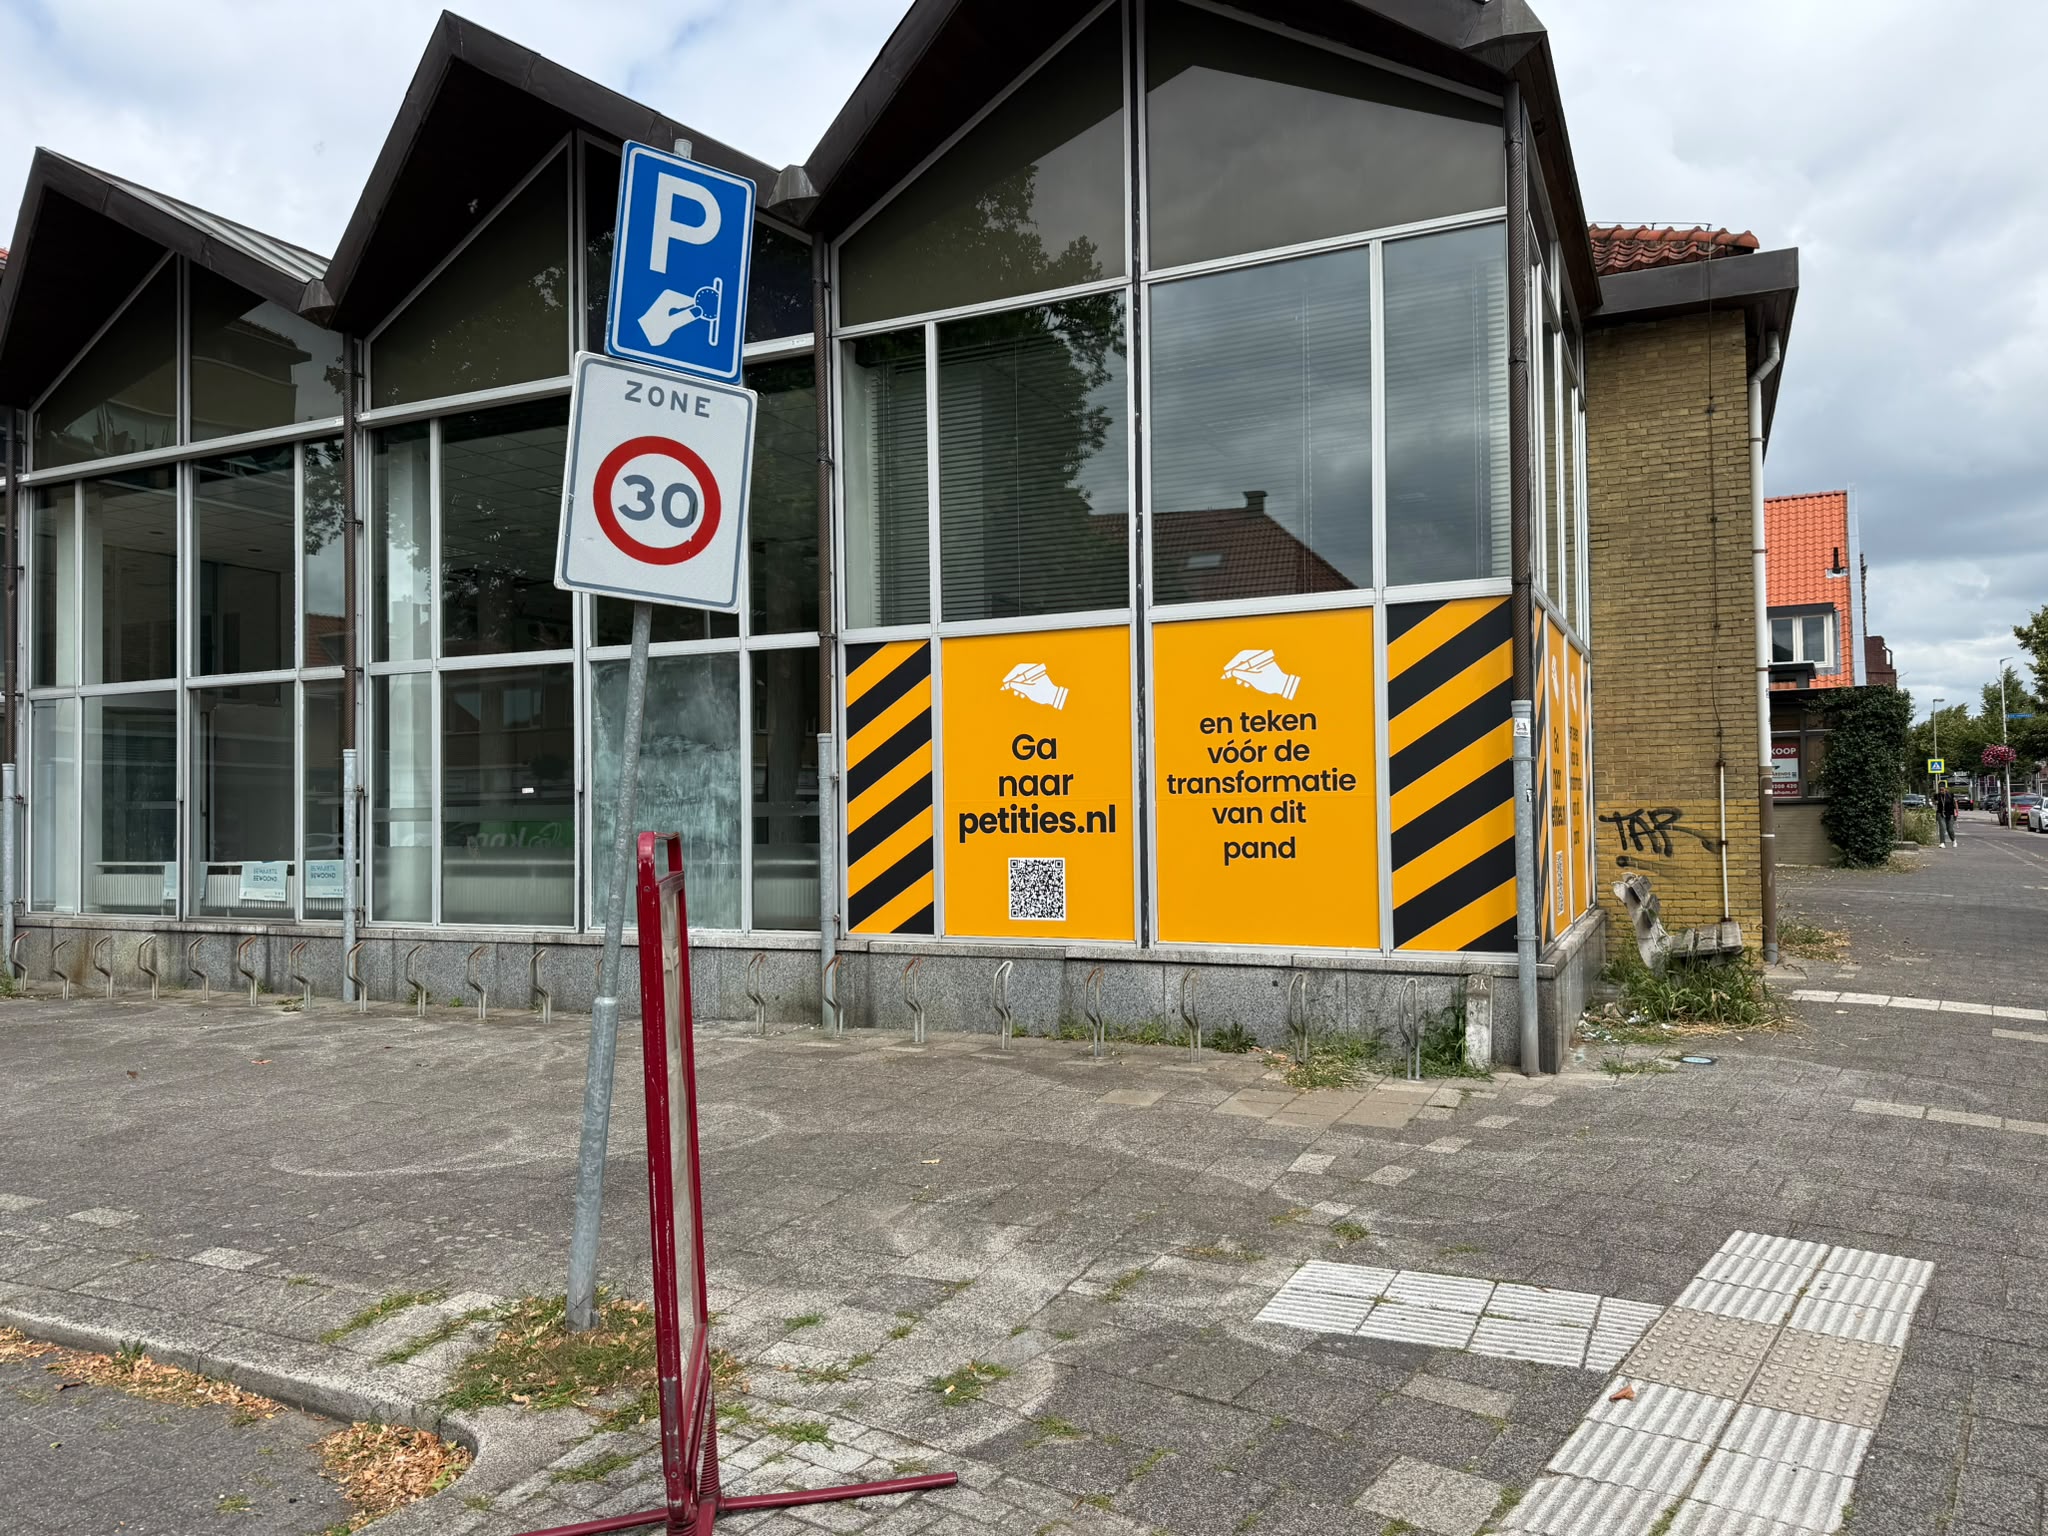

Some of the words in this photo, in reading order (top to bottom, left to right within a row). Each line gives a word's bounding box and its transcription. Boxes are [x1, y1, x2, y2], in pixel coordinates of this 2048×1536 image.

[650, 172, 722, 274] P
[625, 380, 712, 419] ZONE
[618, 474, 698, 529] 30
[1200, 716, 1233, 735] en
[1239, 710, 1317, 733] teken
[1011, 733, 1057, 761] Ga
[1207, 738, 1268, 764] vóór
[1274, 739, 1310, 763] de
[998, 773, 1074, 797] naar
[1166, 767, 1357, 795] transformatie
[959, 803, 1116, 844] petities.nl
[1211, 806, 1263, 825] van
[1270, 799, 1307, 824] dit
[1223, 836, 1296, 867] pand
